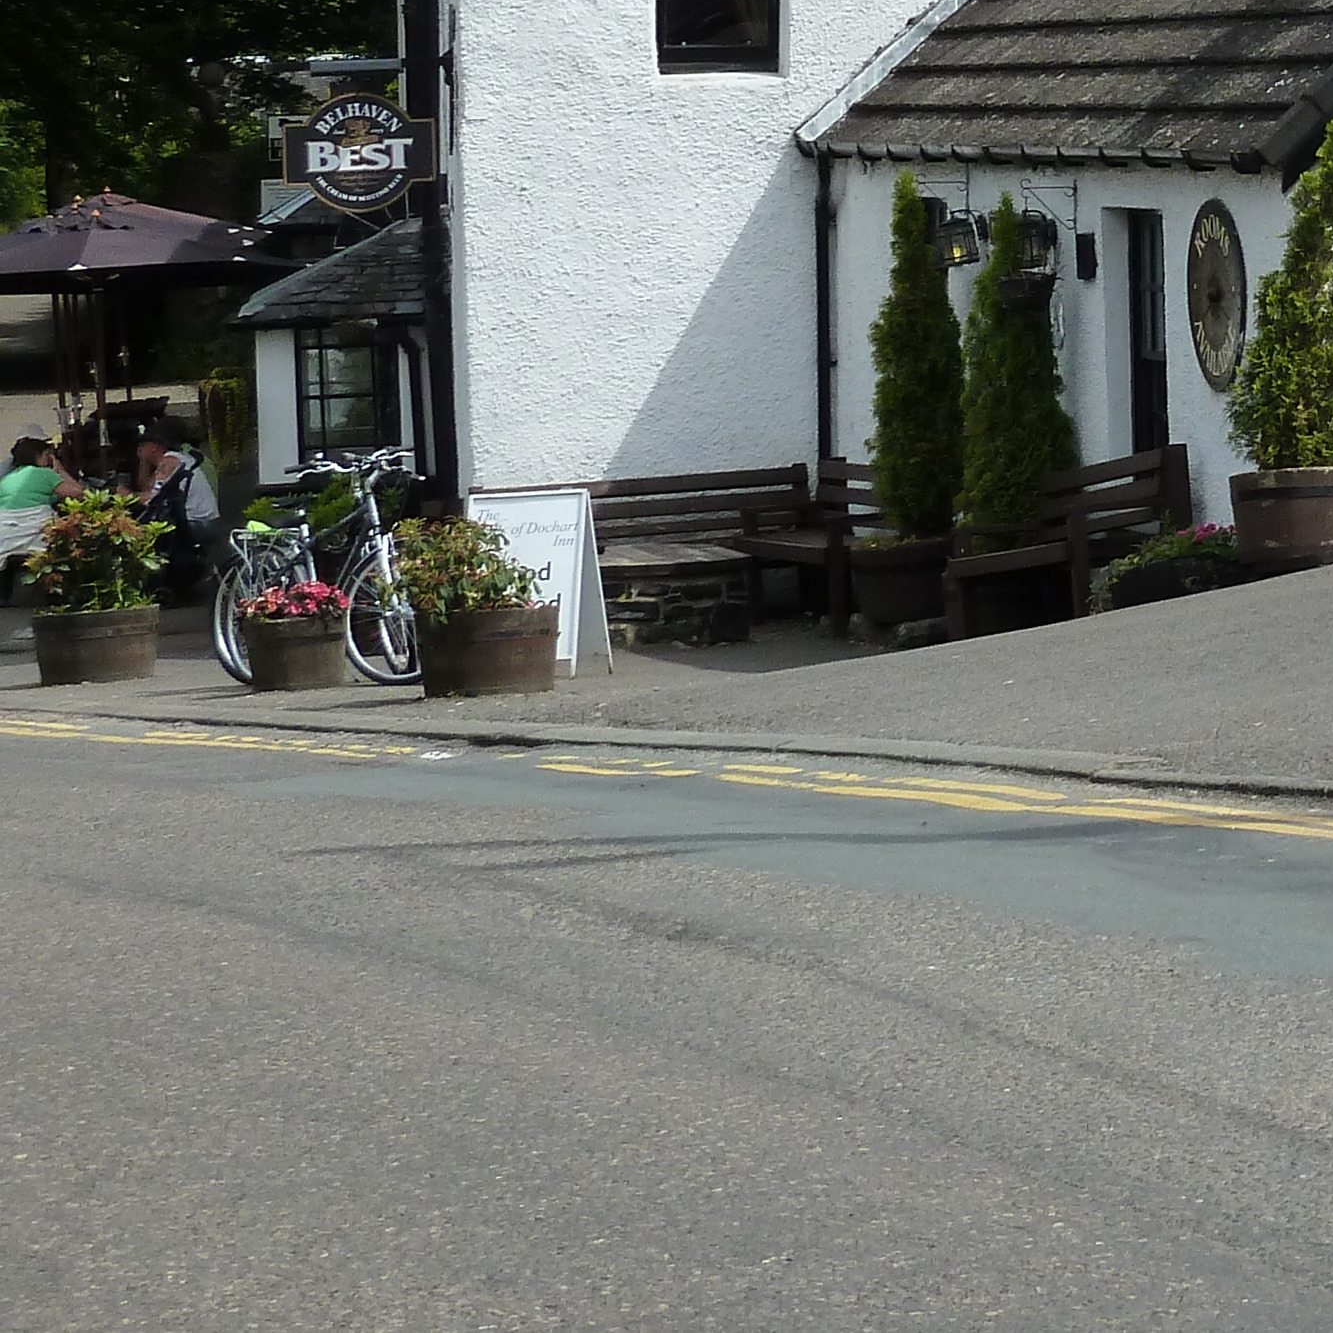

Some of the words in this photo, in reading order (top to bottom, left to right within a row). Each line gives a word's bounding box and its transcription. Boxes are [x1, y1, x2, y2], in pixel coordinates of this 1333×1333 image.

[314, 102, 403, 135] BELHAVEN
[304, 137, 414, 174] BEST
[1193, 213, 1230, 258] ROOMS
[477, 509, 500, 522] The
[511, 522, 527, 538] of
[526, 520, 580, 535] Dochart
[552, 534, 575, 547] Inn
